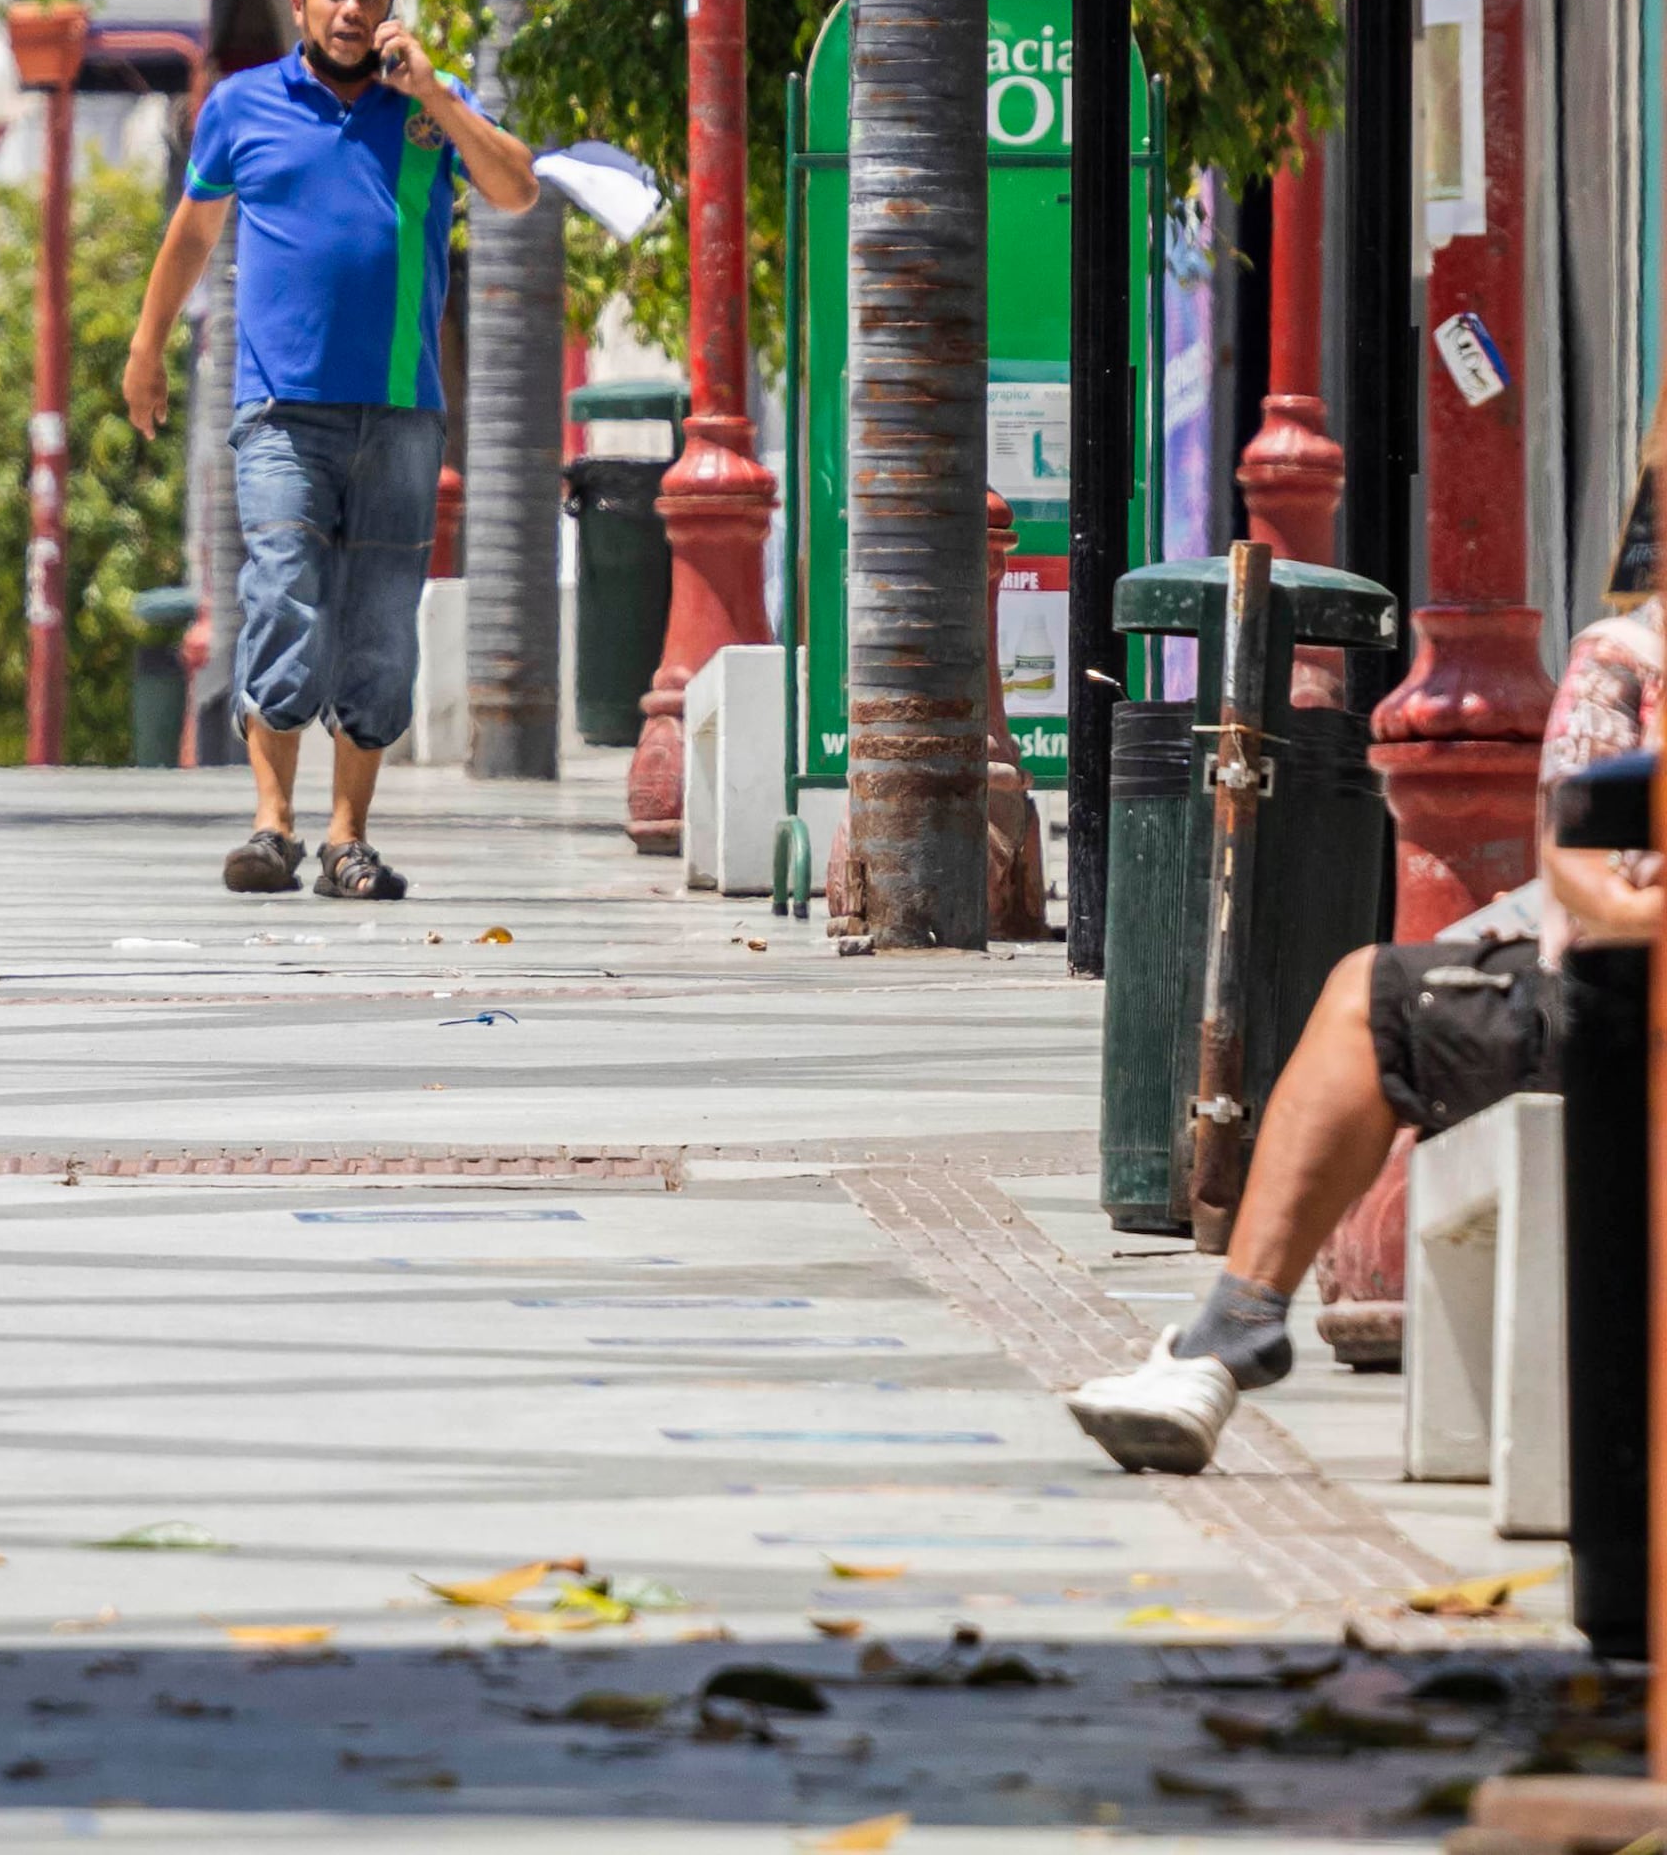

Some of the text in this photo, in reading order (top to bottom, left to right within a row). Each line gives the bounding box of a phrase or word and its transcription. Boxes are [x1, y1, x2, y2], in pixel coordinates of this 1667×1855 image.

[987, 24, 1073, 73] acia
[1000, 571, 1040, 590] RIPE
[1015, 726, 1069, 758] skn
